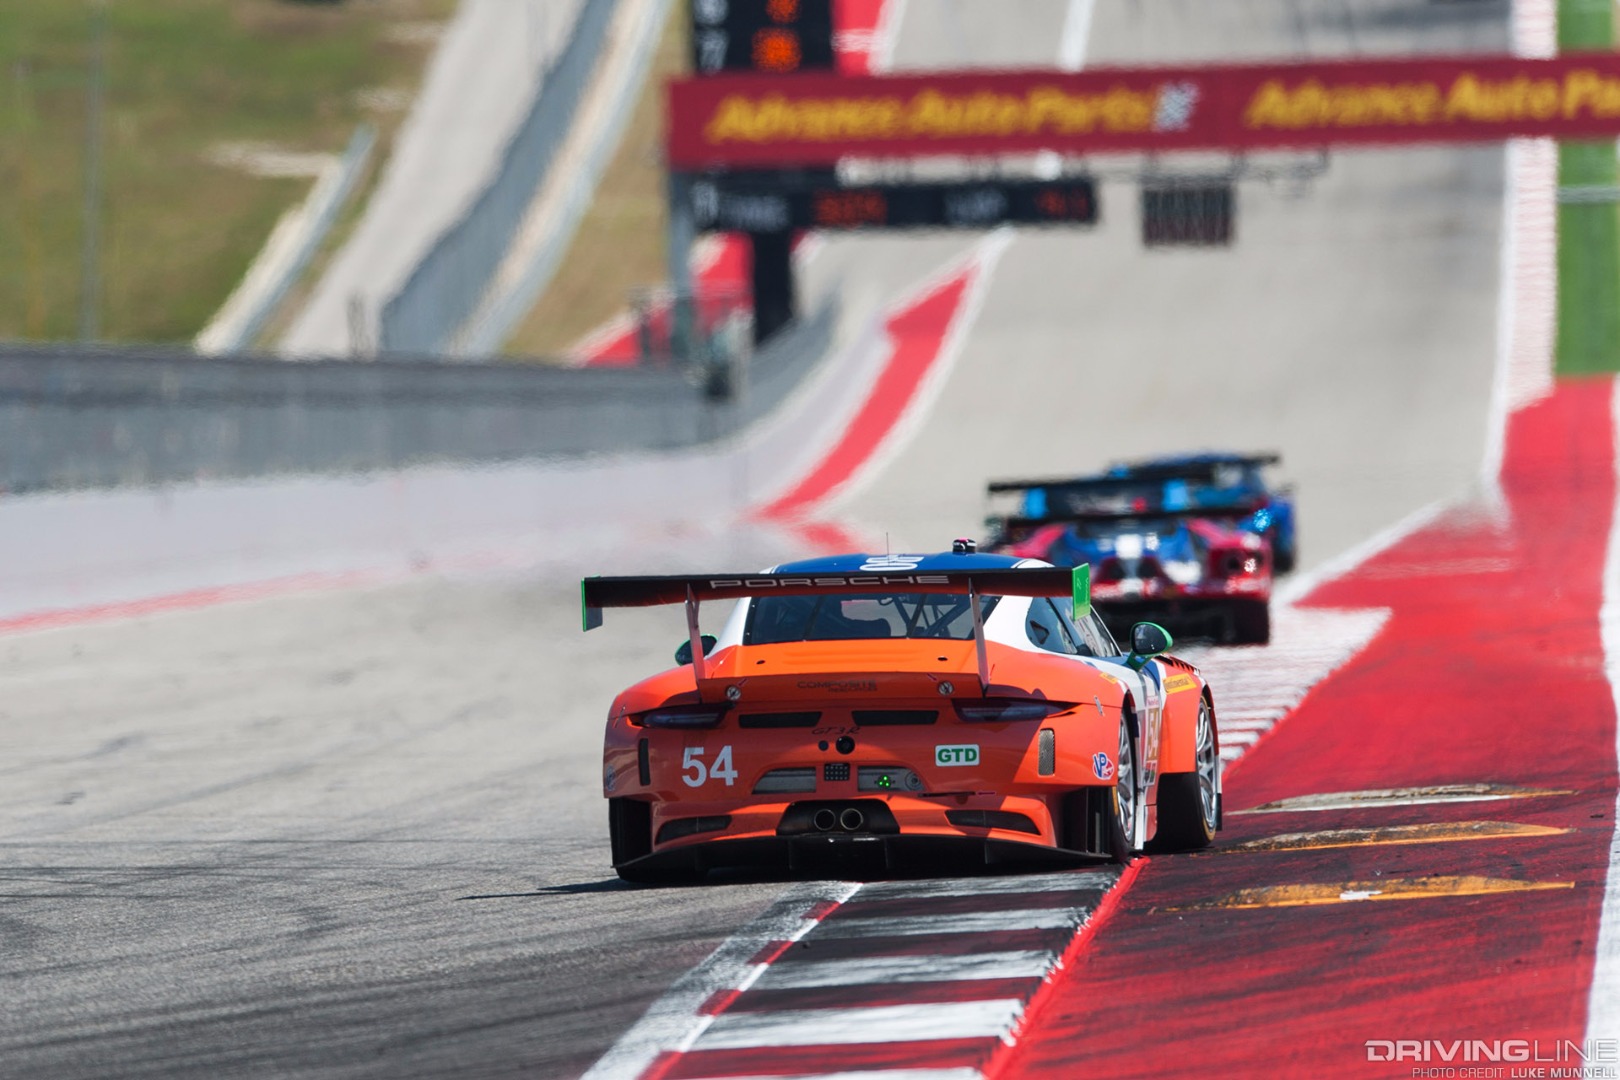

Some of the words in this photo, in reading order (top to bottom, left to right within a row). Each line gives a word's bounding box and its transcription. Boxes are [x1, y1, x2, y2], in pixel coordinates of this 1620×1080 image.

[708, 96, 898, 143] Advance
[904, 89, 1025, 134] Auto
[1027, 86, 1153, 133] Parts
[1245, 78, 1441, 130] Advance
[1446, 71, 1558, 122] Auto
[710, 575, 949, 589] PORSCHE
[682, 746, 738, 787] 54
[937, 748, 977, 763] GTD
